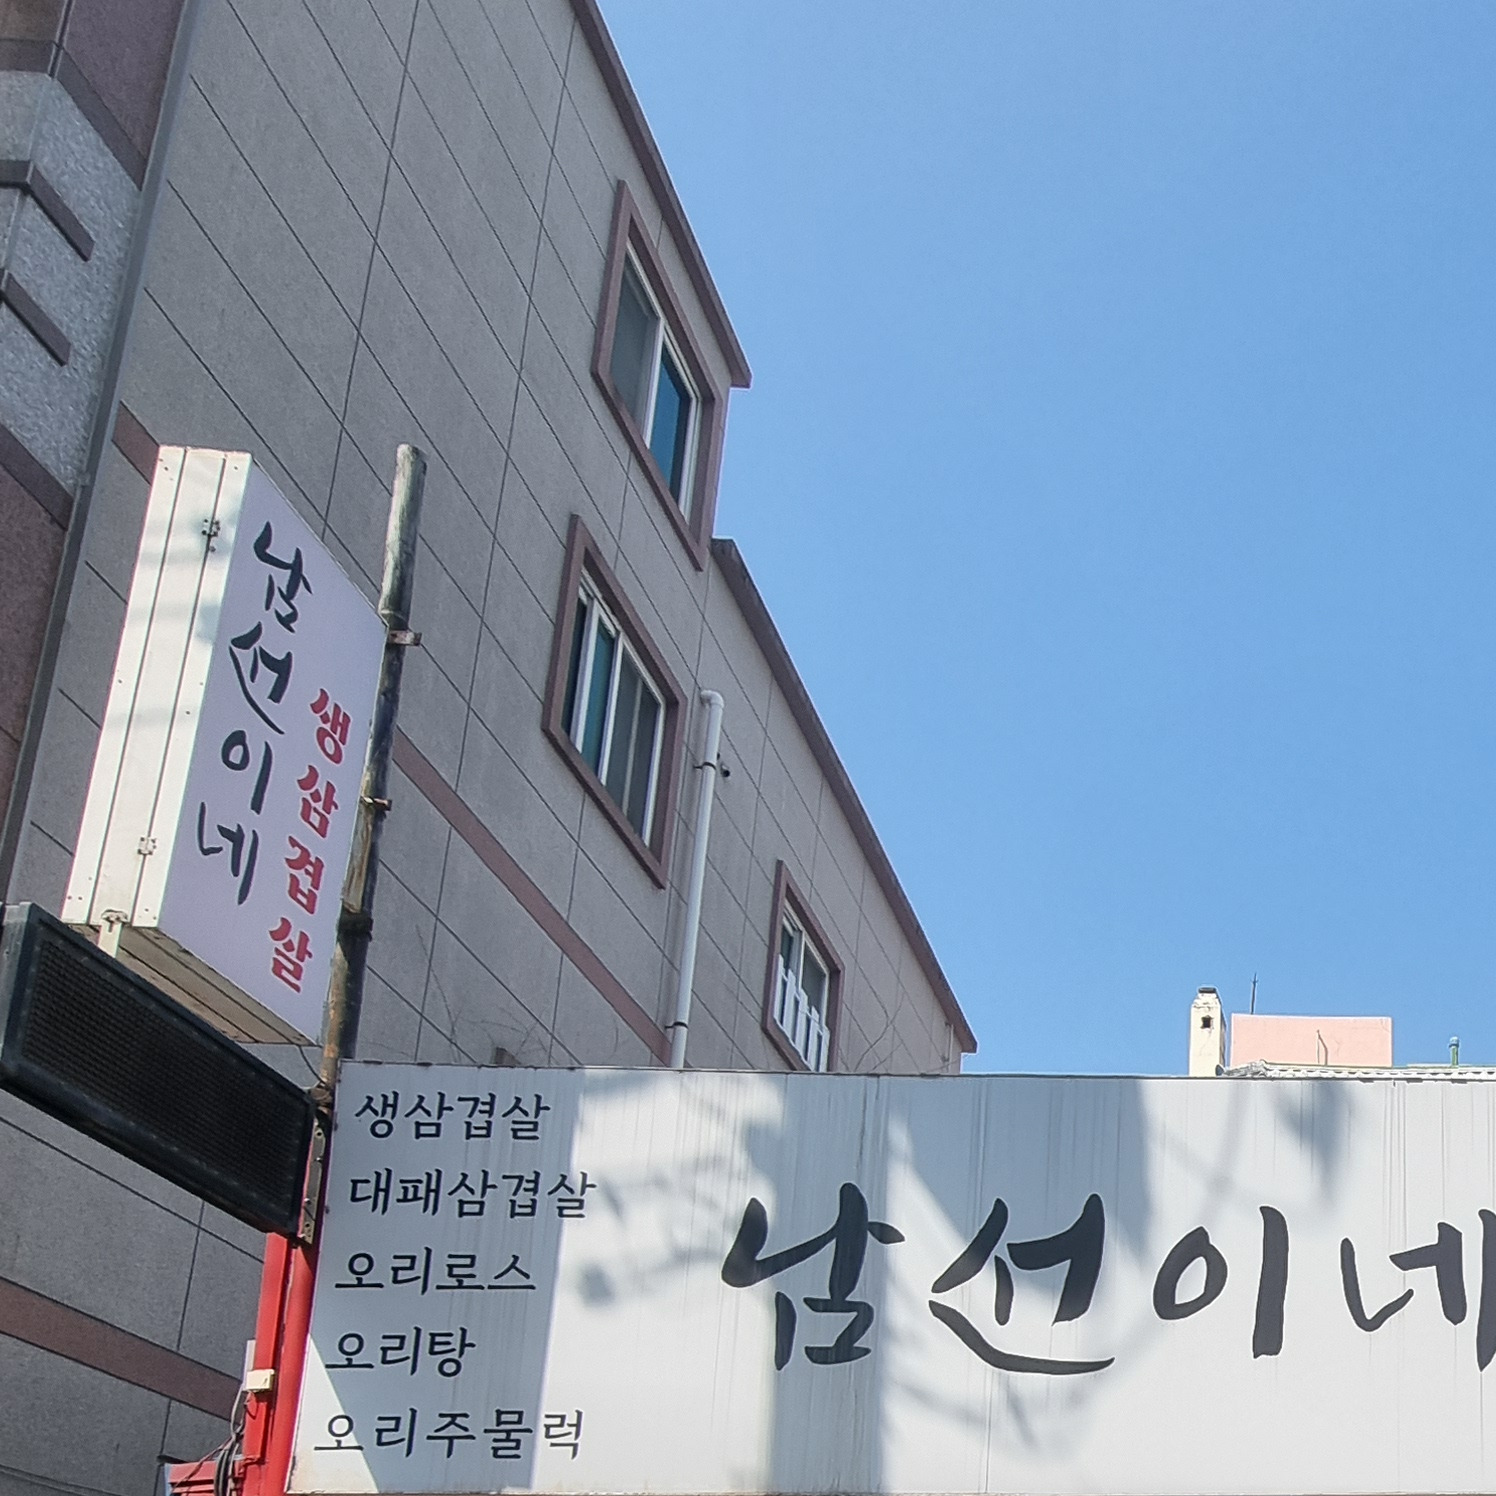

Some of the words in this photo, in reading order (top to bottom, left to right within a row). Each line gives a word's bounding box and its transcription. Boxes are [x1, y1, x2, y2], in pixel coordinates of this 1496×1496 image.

[198, 521, 313, 905] 남선이네
[267, 688, 352, 993] 생삼겹살
[354, 1092, 551, 1140] 생삼겹살
[350, 1168, 598, 1220] 대패삼겹살
[335, 1247, 537, 1292] 오리로스
[325, 1326, 476, 1378] 오리탕
[313, 1407, 584, 1459] 오리주물럭
